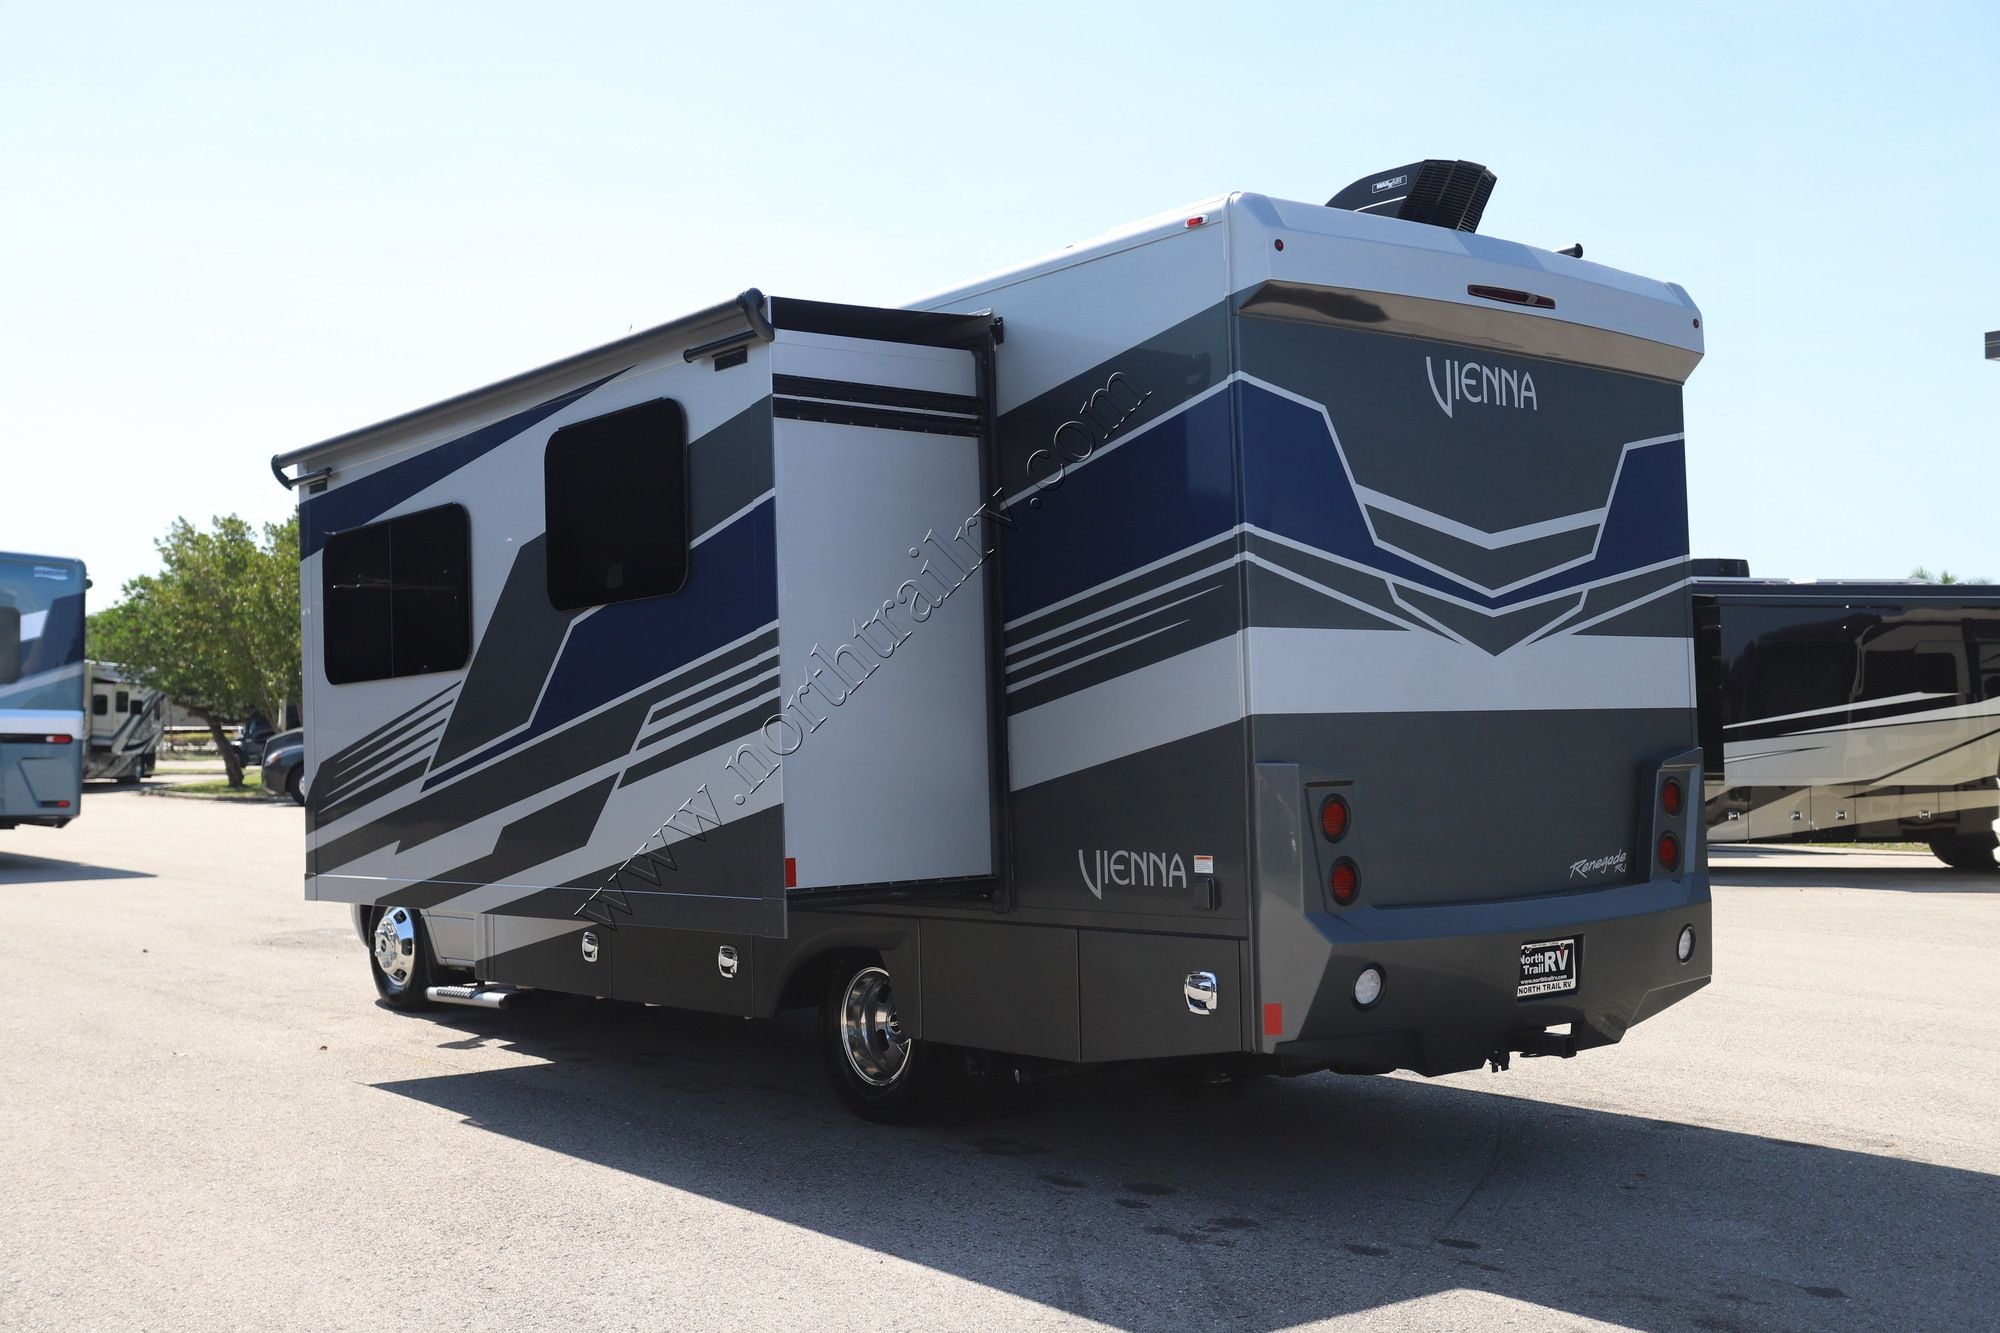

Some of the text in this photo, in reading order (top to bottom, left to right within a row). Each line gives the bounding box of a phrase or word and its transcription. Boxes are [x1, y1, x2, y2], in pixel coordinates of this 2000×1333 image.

[1425, 356, 1538, 419] VIENNA
[1569, 848, 1627, 880] Renegade
[1614, 863, 1627, 873] RV
[1078, 849, 1187, 901] VIENNA
[1520, 952, 1544, 965] North
[1544, 949, 1569, 973] RV
[1522, 963, 1544, 975] Trail
[1518, 980, 1572, 995] NORTH TRAIL RV
